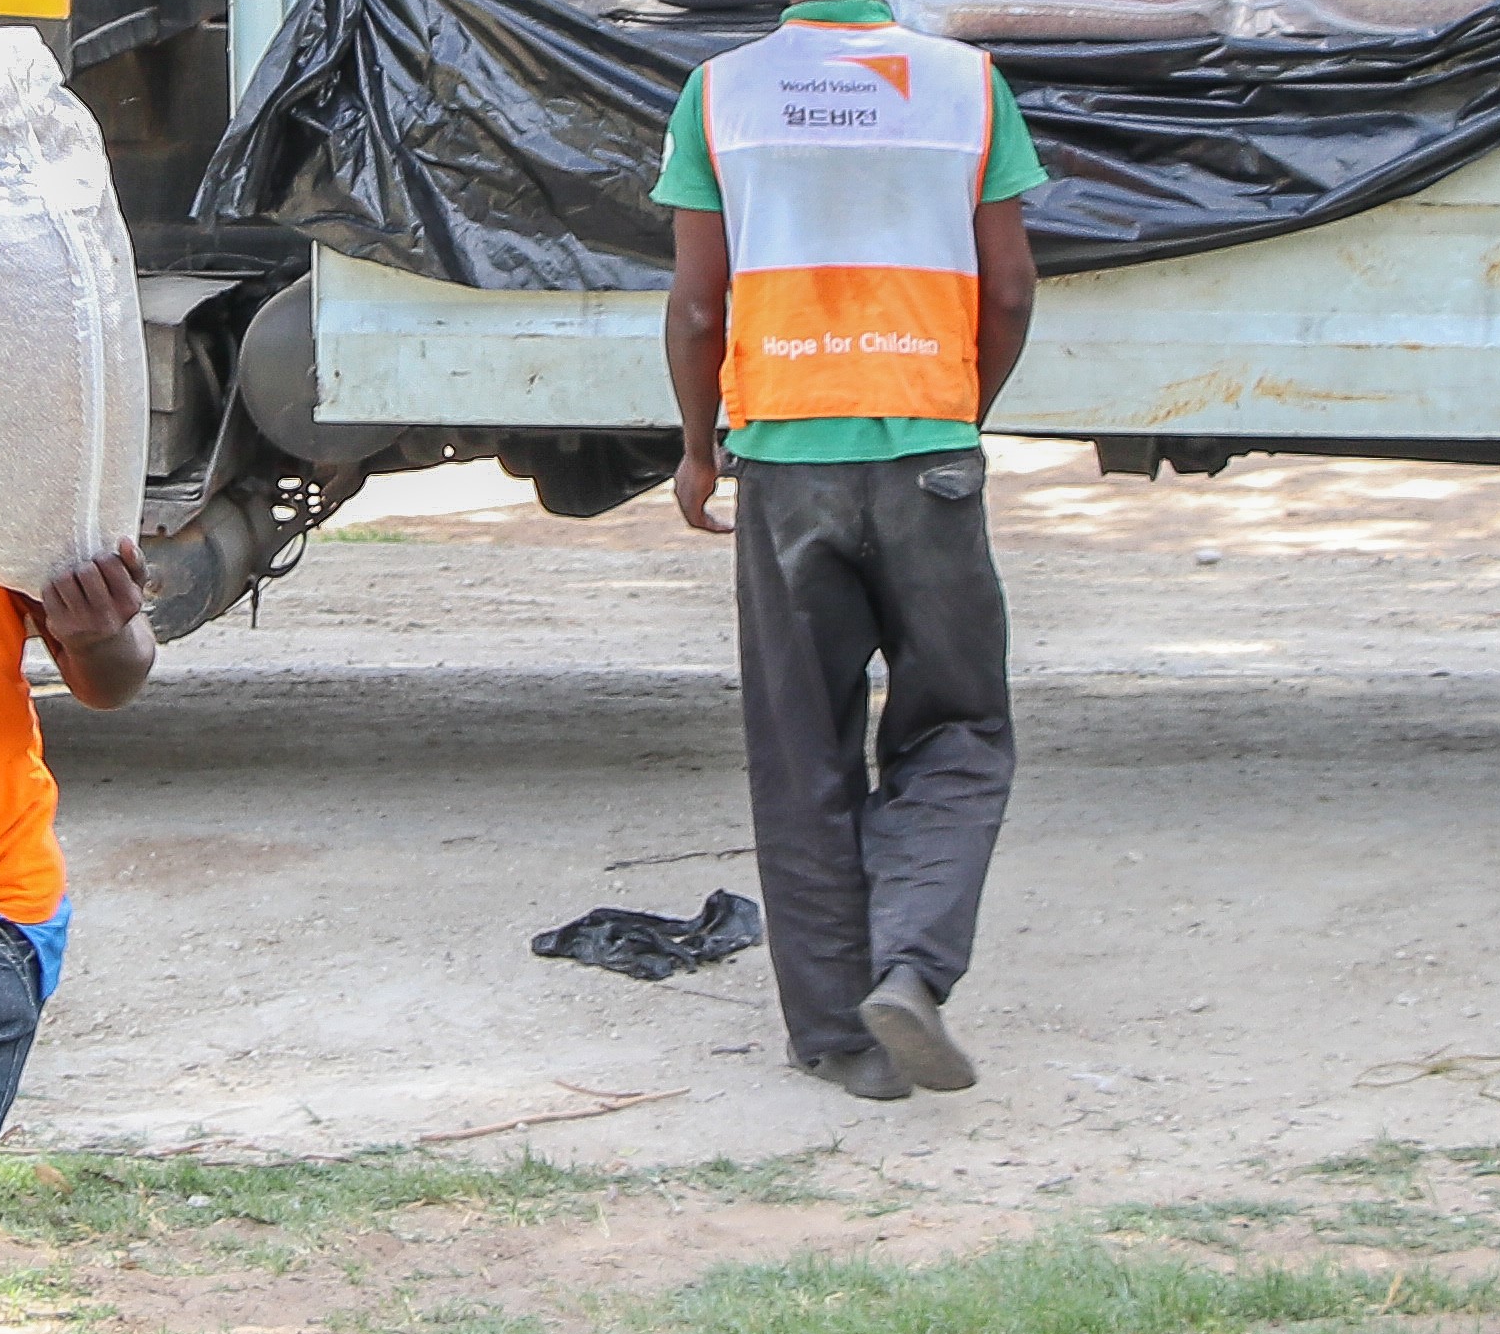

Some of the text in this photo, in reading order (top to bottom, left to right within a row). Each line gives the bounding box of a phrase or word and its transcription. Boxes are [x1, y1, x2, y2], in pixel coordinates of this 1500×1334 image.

[780, 78, 878, 93] World Vision
[782, 103, 879, 128] 월드비전
[762, 331, 941, 360] Hope for Children
